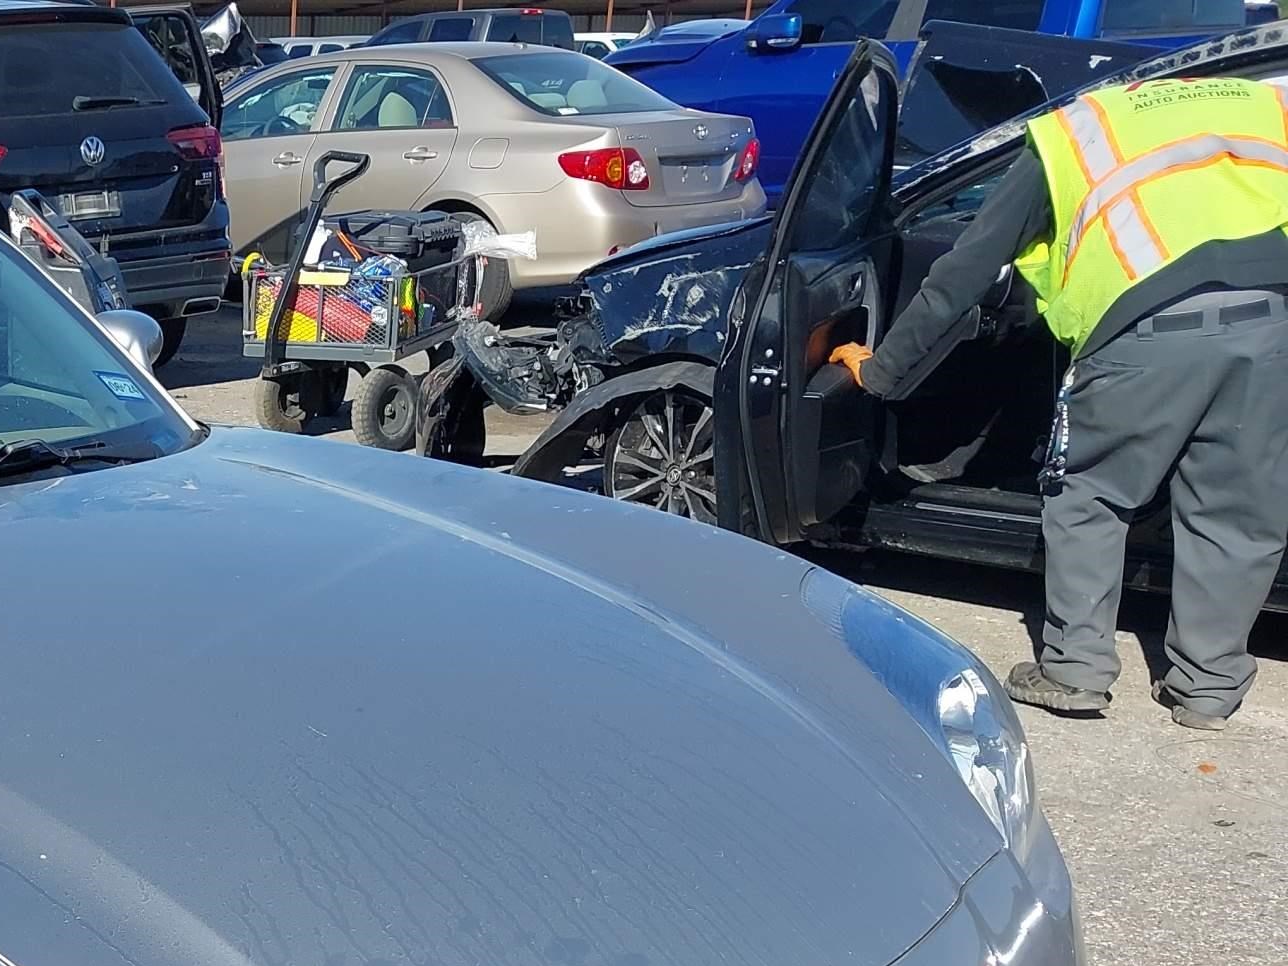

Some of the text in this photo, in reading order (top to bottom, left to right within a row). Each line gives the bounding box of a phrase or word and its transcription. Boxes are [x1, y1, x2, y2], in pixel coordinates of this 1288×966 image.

[1128, 82, 1244, 101] INSURANCE
[1133, 90, 1250, 111] AUTO AUCTIONS
